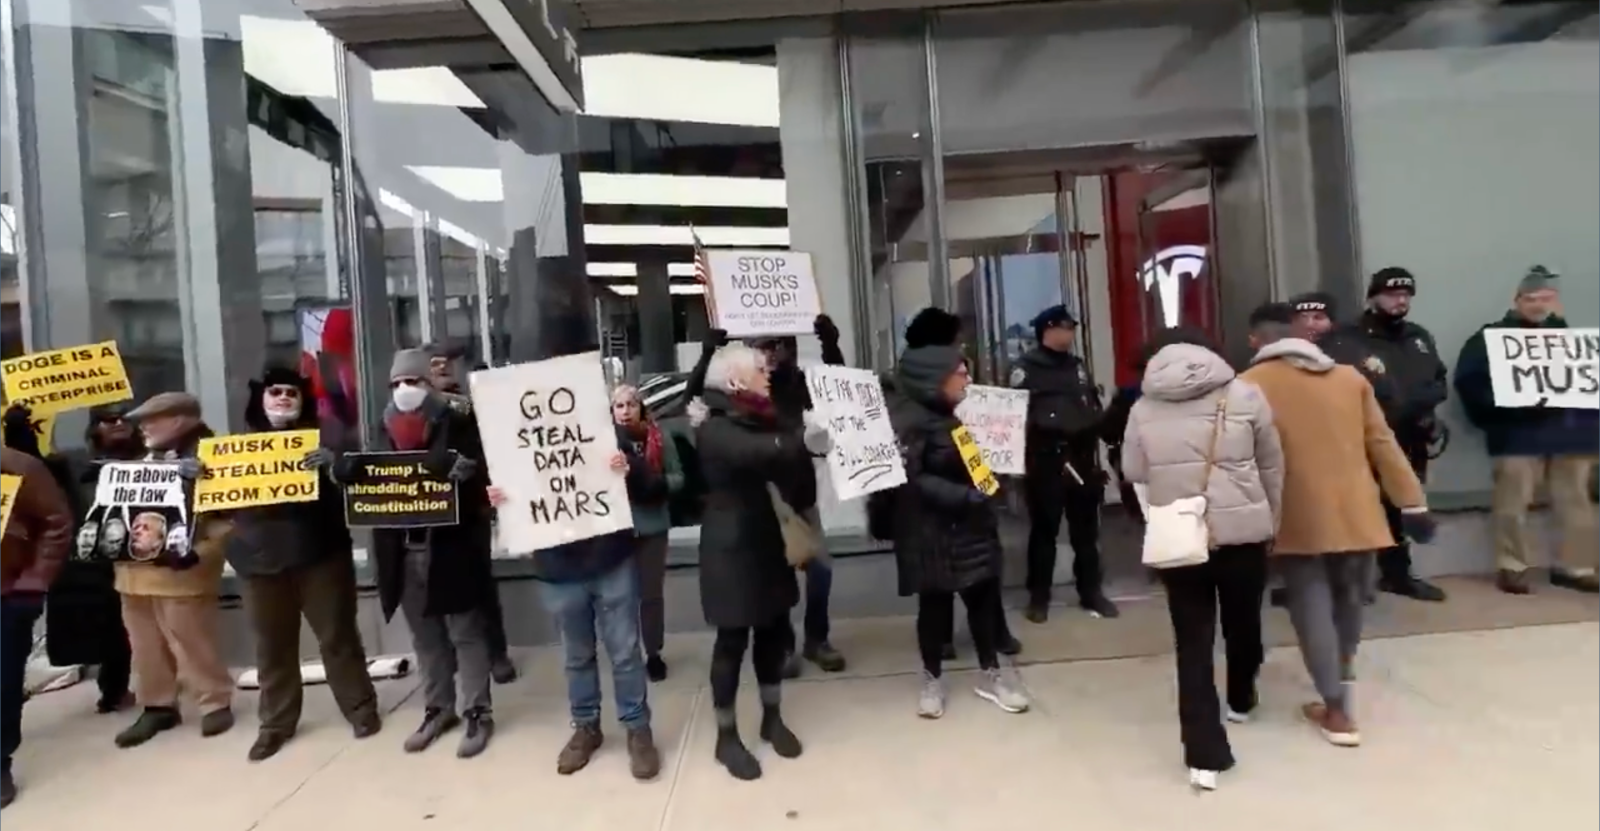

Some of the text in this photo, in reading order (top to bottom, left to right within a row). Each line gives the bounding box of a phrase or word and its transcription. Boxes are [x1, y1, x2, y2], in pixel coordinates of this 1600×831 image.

[737, 256, 786, 272] STOP
[731, 274, 799, 290] MUSK'S
[740, 292, 798, 308] COUP!
[5, 346, 114, 375] DOGE IS A
[18, 366, 111, 390] CRIMINAL
[1512, 364, 1599, 395] MUS
[520, 387, 575, 420] GO
[212, 436, 304, 455] MUSK IS
[517, 423, 595, 449] STEAL
[534, 446, 585, 472] DATA
[109, 466, 178, 484] I'm above
[364, 464, 413, 478] Trump
[199, 481, 316, 505] FROM YOU
[347, 480, 452, 497] shredding The
[549, 474, 576, 493] ON
[113, 486, 168, 503] the law
[530, 490, 610, 523] MARS
